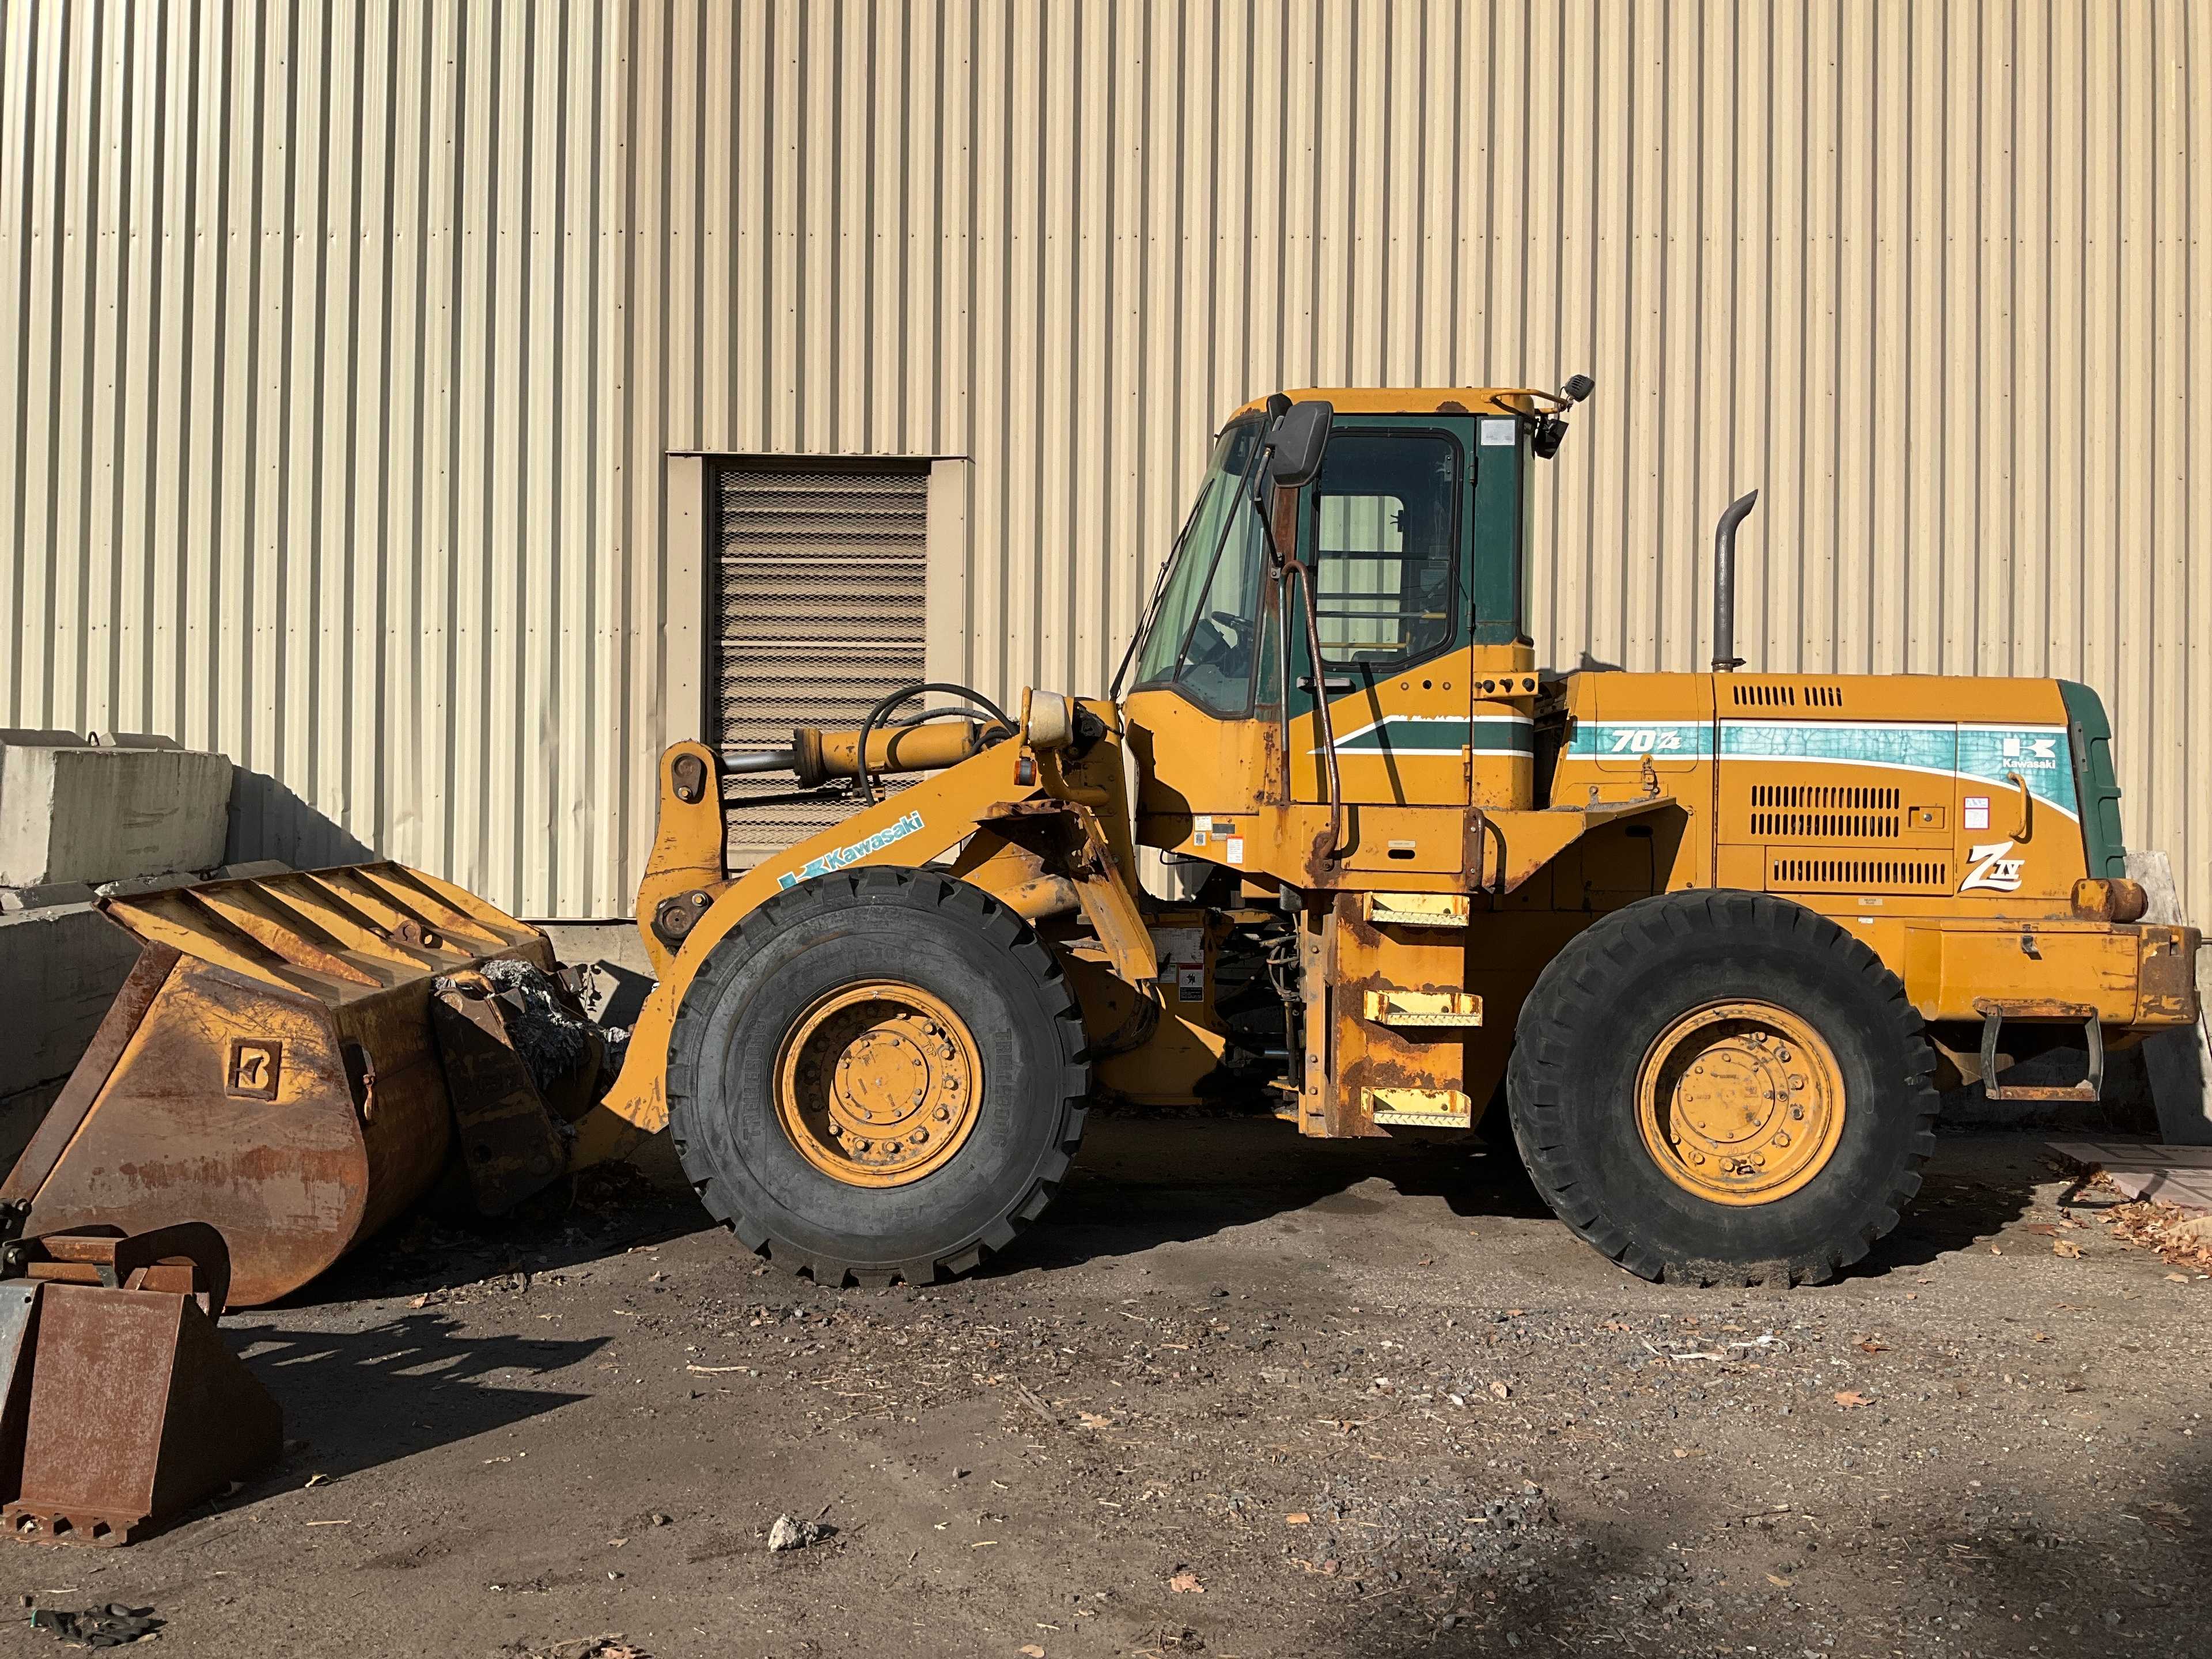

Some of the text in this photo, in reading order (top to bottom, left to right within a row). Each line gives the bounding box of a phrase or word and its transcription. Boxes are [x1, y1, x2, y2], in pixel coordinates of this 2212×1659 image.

[1611, 729, 1656, 752] 70
[2003, 758, 2056, 769] Kawasaki
[825, 811, 924, 870] Kawasaki
[922, 1039, 937, 1057] TOP
[743, 1018, 766, 1141] TRELLEBORG
[990, 1028, 1013, 1148] TRELLEBORG
